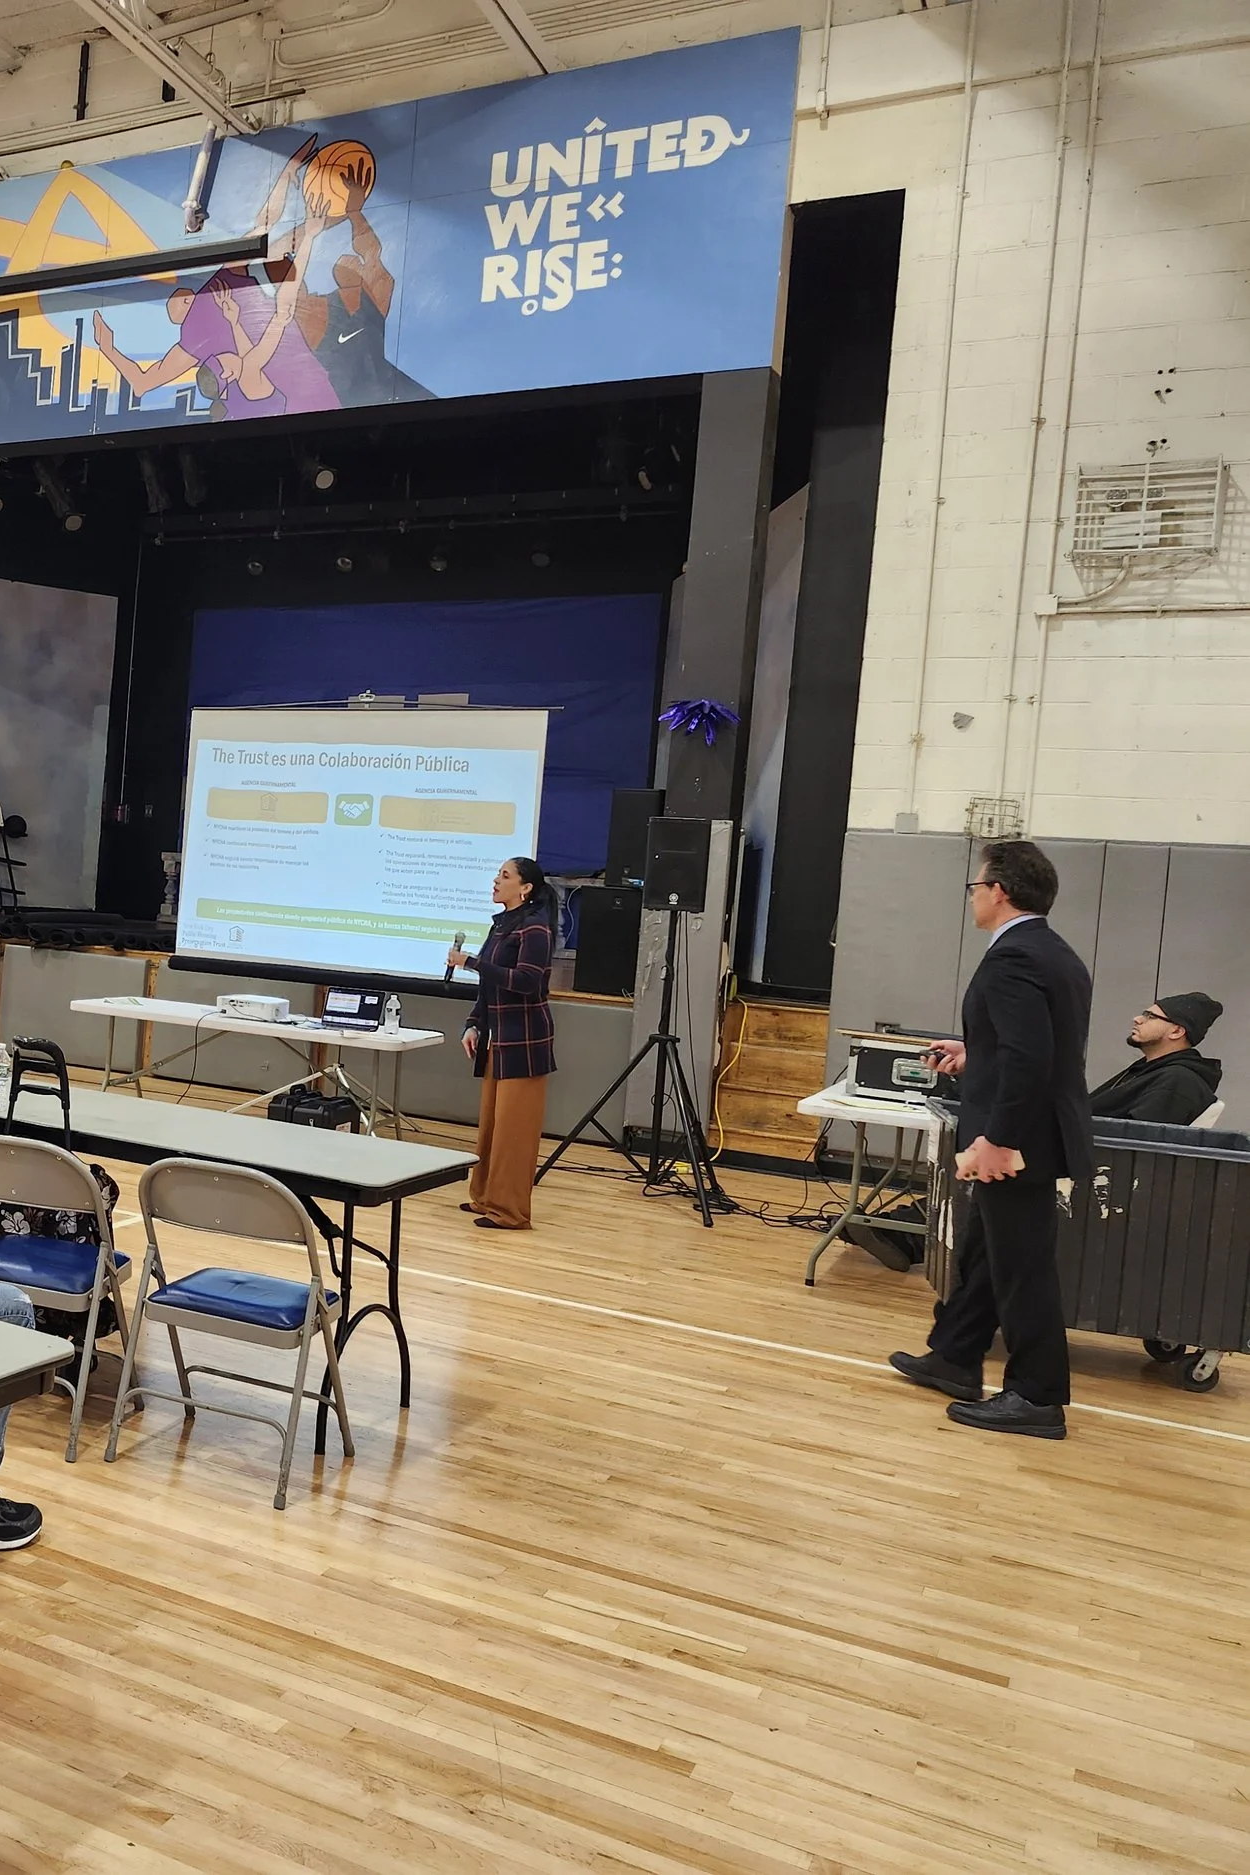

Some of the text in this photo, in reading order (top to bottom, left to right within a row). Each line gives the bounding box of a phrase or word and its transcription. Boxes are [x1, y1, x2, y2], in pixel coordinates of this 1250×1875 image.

[484, 191, 583, 251] WE
[212, 747, 470, 773] The Trust es una Colaboración Pública
